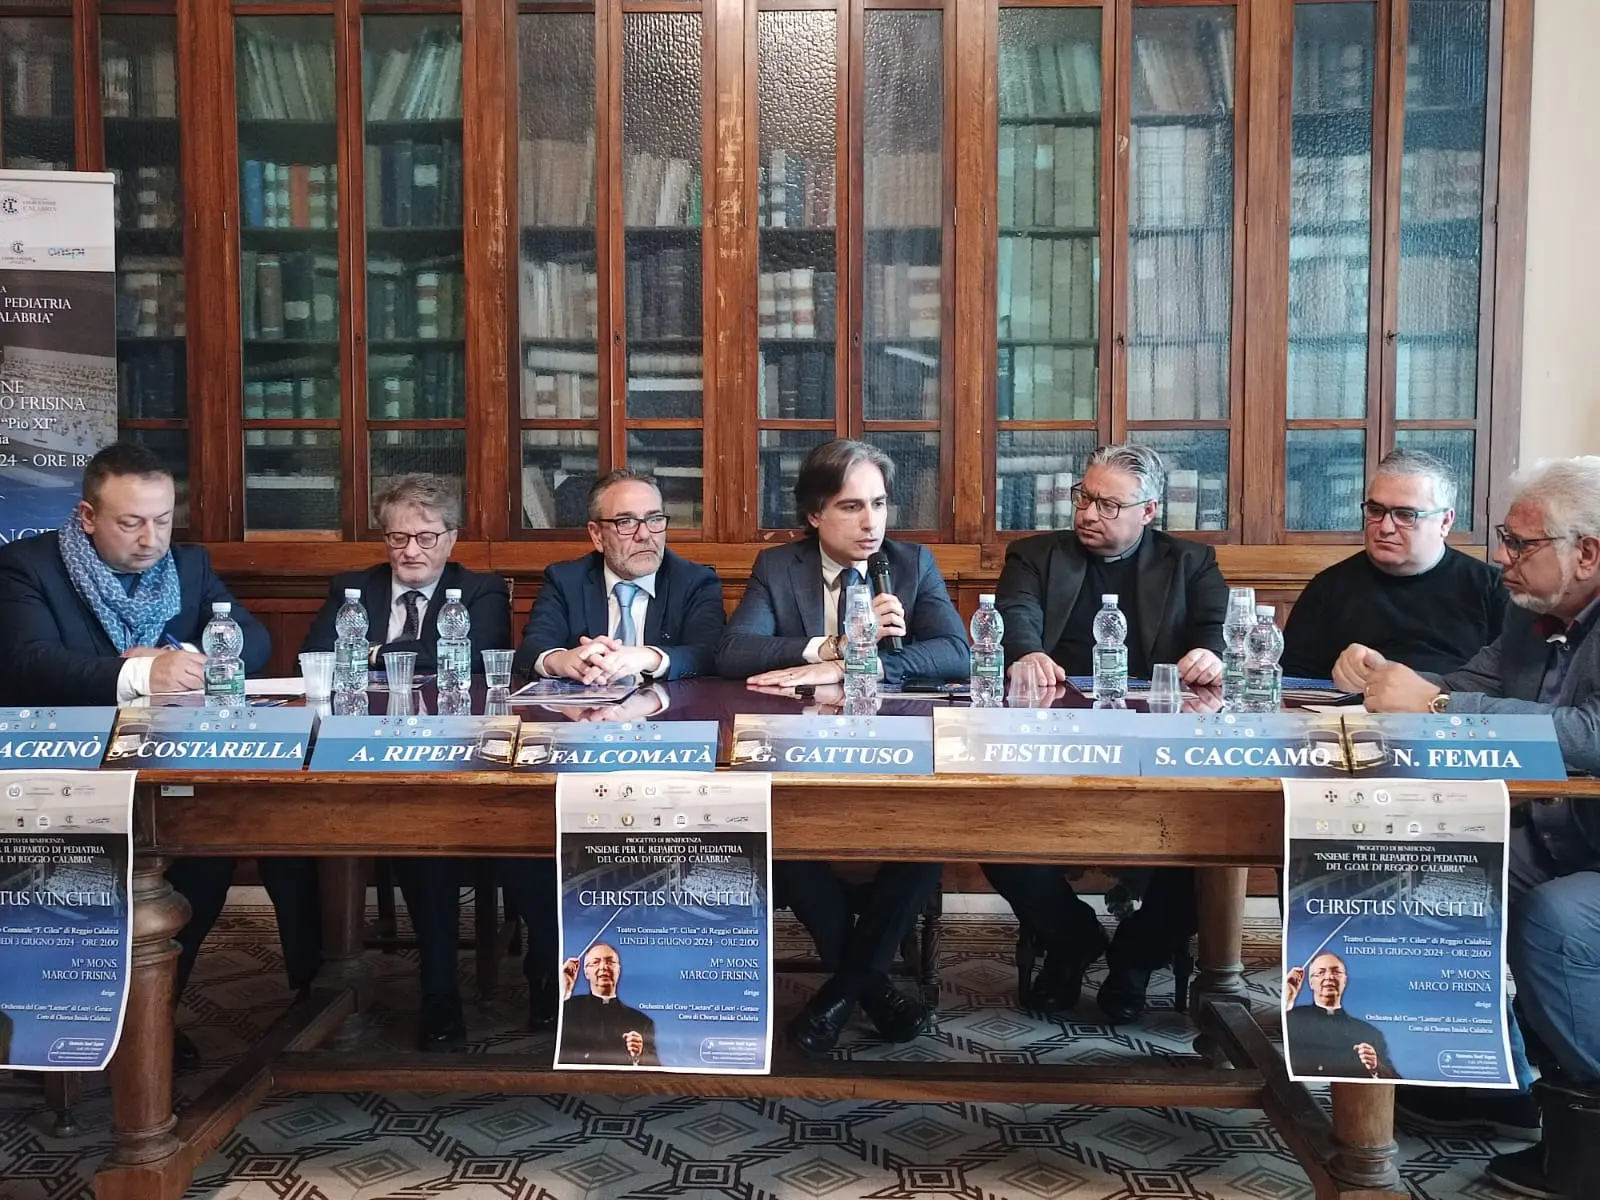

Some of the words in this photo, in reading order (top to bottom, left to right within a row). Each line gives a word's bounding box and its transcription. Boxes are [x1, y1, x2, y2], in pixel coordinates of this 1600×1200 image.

[4, 297, 72, 309] PEDIATRIA
[0, 380, 24, 394] NE
[0, 396, 14, 410] O
[20, 396, 86, 410] FRISINA
[0, 454, 18, 467] 24
[33, 454, 66, 467] ORE
[0, 736, 101, 758] ACRINÒ
[137, 741, 304, 758] COSTARELLA
[348, 746, 374, 762] A.
[384, 746, 477, 762] RIPEPI
[547, 745, 713, 765] FALCOMATÀ
[751, 745, 776, 764] G.
[784, 745, 914, 764] GATTUSO
[983, 744, 1124, 764] FESTICINI
[1155, 747, 1176, 767] S.
[1184, 747, 1330, 767] CACCAMO
[1392, 748, 1420, 768] N.
[1427, 748, 1522, 768] FEMIA
[4, 845, 12, 854] IL
[14, 845, 50, 854] REPARTO
[52, 845, 60, 854] DI
[63, 845, 105, 854] PEDIATRIA
[622, 846, 636, 854] PER
[638, 846, 646, 854] IL
[648, 846, 686, 854] REPARTO
[688, 846, 698, 854] DI
[700, 846, 742, 854] PEDIATRIA
[597, 856, 612, 864] DEL
[642, 856, 652, 864] DI
[654, 856, 686, 864] REGGIO
[1352, 852, 1368, 861] PER
[1370, 853, 1378, 861] IL
[1380, 852, 1420, 862] REPARTO
[1421, 854, 1431, 862] DI
[1433, 854, 1478, 863] PEDIATRIA
[1326, 862, 1342, 870] DEL
[1372, 863, 1382, 872] DI
[1384, 864, 1418, 872] REGGIO
[34, 890, 96, 906] VINCIT
[101, 890, 111, 906] II
[579, 890, 666, 906] CHRISTUS
[670, 890, 734, 906] VINCIT
[739, 890, 750, 906] II
[1306, 898, 1396, 915] CHRISTUS
[1400, 898, 1467, 916] VINCIT
[1472, 902, 1484, 916] II
[616, 927, 636, 935] Teatro
[638, 927, 668, 935] Comunale
[701, 927, 708, 935] di
[708, 928, 732, 936] Reggio
[732, 927, 759, 935] Calabria
[14, 938, 19, 946] 3
[21, 938, 54, 946] GIUGNO
[56, 938, 74, 946] 2024
[82, 938, 98, 946] ORE
[619, 937, 648, 946] LUNEDÌ
[650, 937, 655, 946] 3
[657, 937, 692, 946] GIUGNO
[694, 937, 713, 946] 2024
[720, 937, 738, 946] ORE
[1345, 946, 1376, 954] LUNEDÌ
[1384, 948, 1422, 956] GIUGNO
[1424, 948, 1443, 956] 2024
[42, 970, 78, 980] MARCO
[81, 970, 117, 980] FRISINA
[679, 970, 718, 980] MARCO
[720, 970, 760, 980] FRISINA
[1408, 981, 1449, 991] MARCO
[1452, 982, 1492, 992] FRISINA
